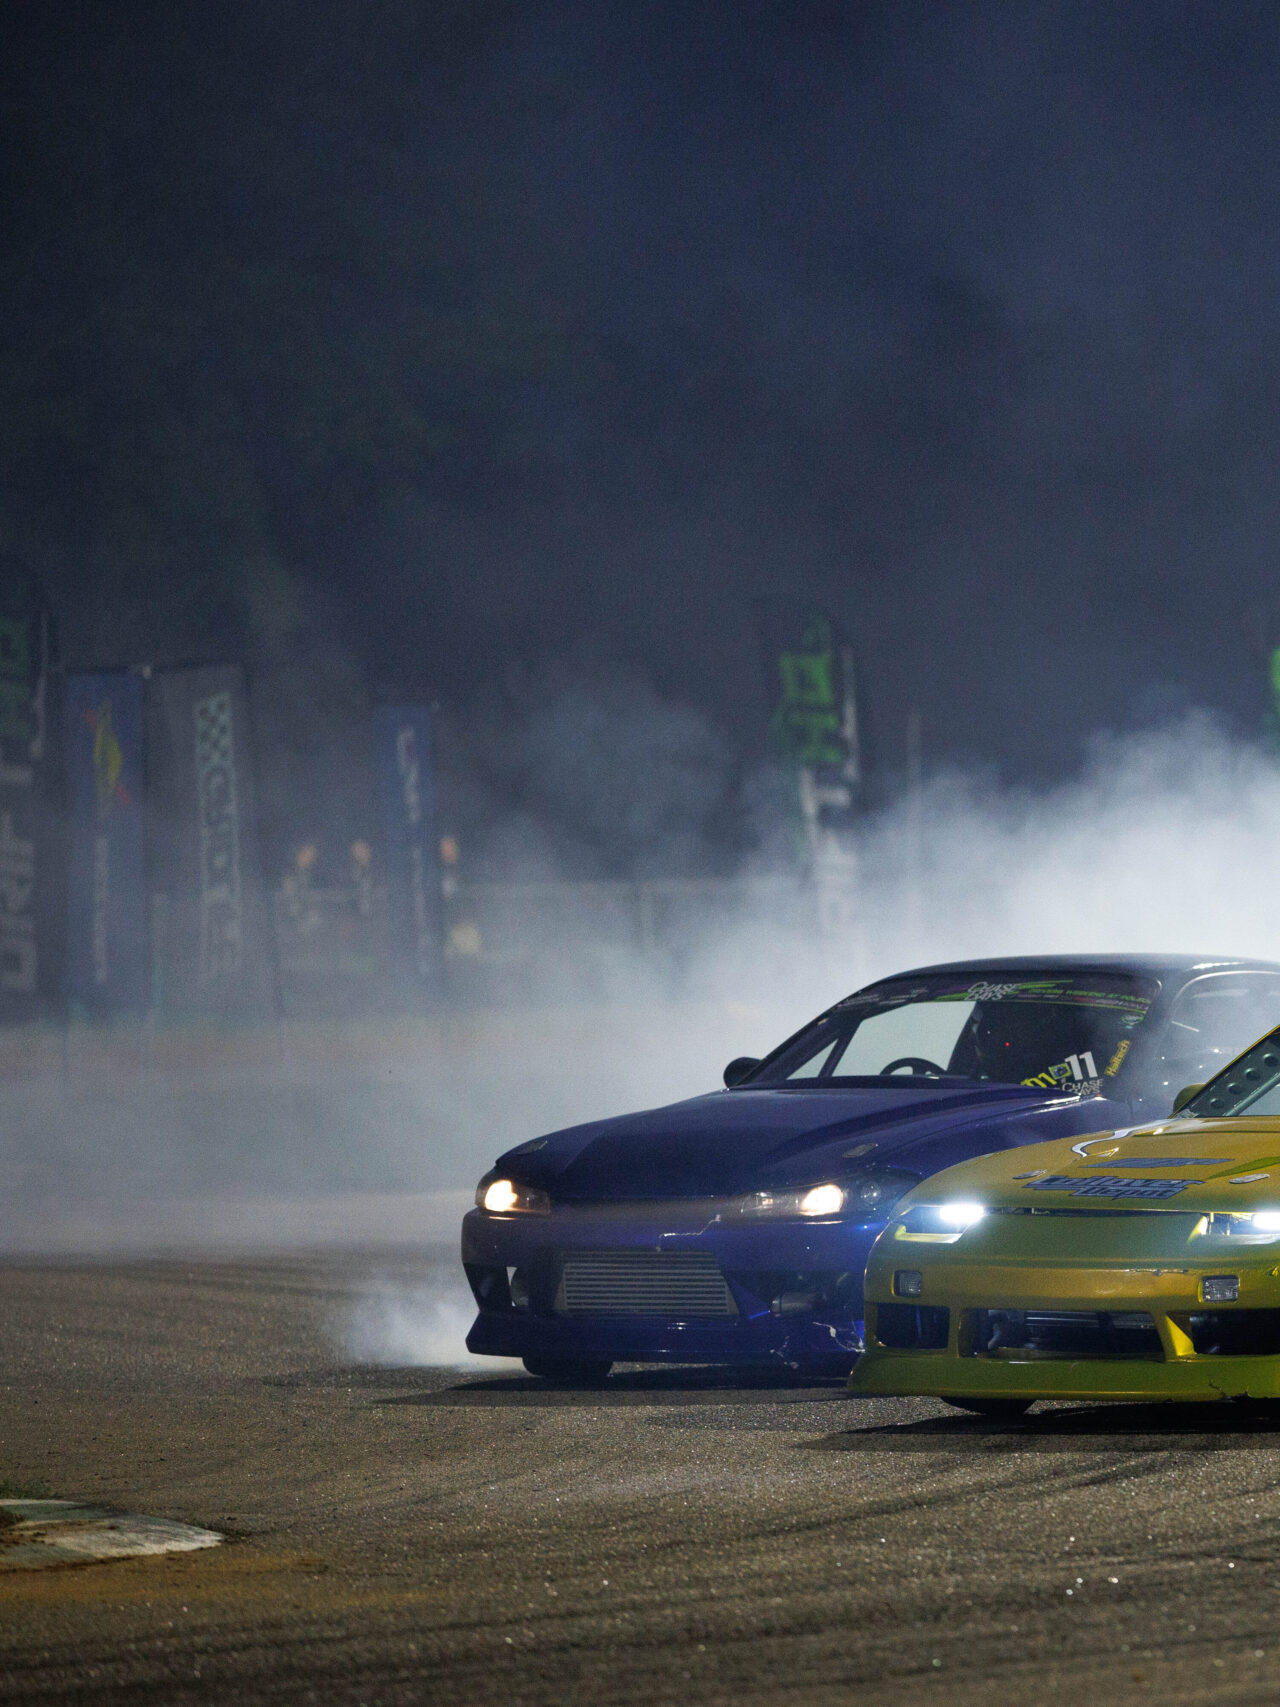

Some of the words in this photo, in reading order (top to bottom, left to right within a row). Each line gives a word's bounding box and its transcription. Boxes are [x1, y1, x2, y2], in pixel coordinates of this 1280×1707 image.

[1064, 1051, 1098, 1081] 11
[1103, 1038, 1132, 1077] Haltech
[1061, 1078, 1104, 1092] CHASE
